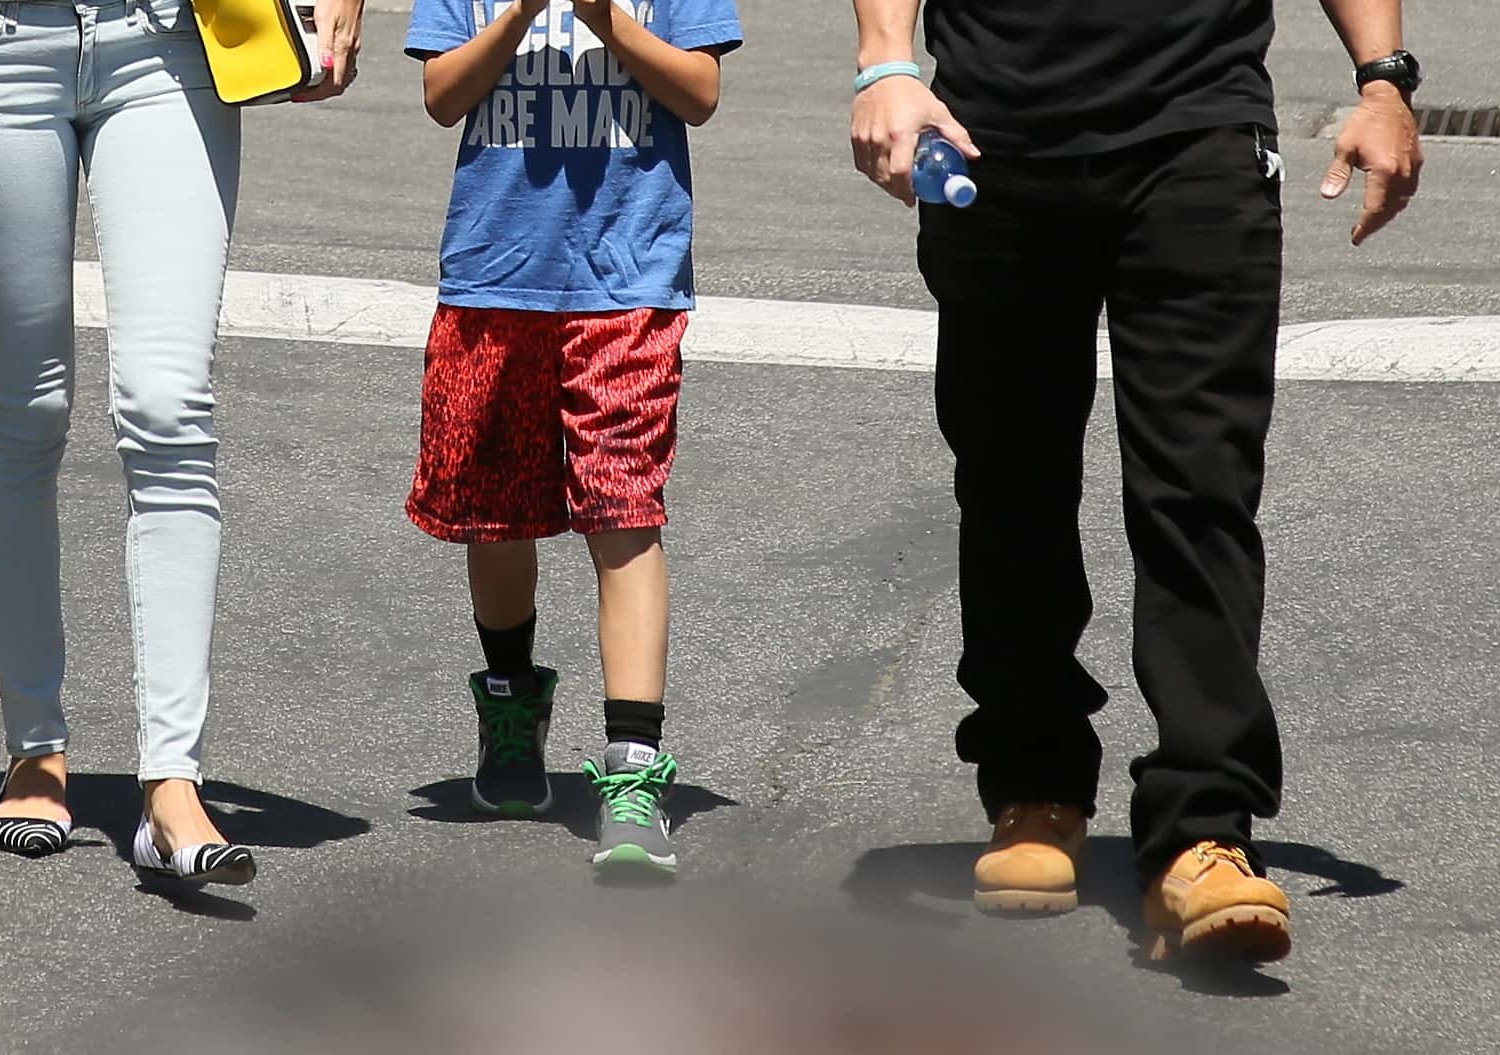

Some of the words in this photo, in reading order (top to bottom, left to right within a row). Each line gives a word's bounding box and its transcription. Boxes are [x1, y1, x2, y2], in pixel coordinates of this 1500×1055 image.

[467, 89, 537, 148] ARE
[551, 89, 654, 148] MADE
[630, 748, 653, 762] NIKE
